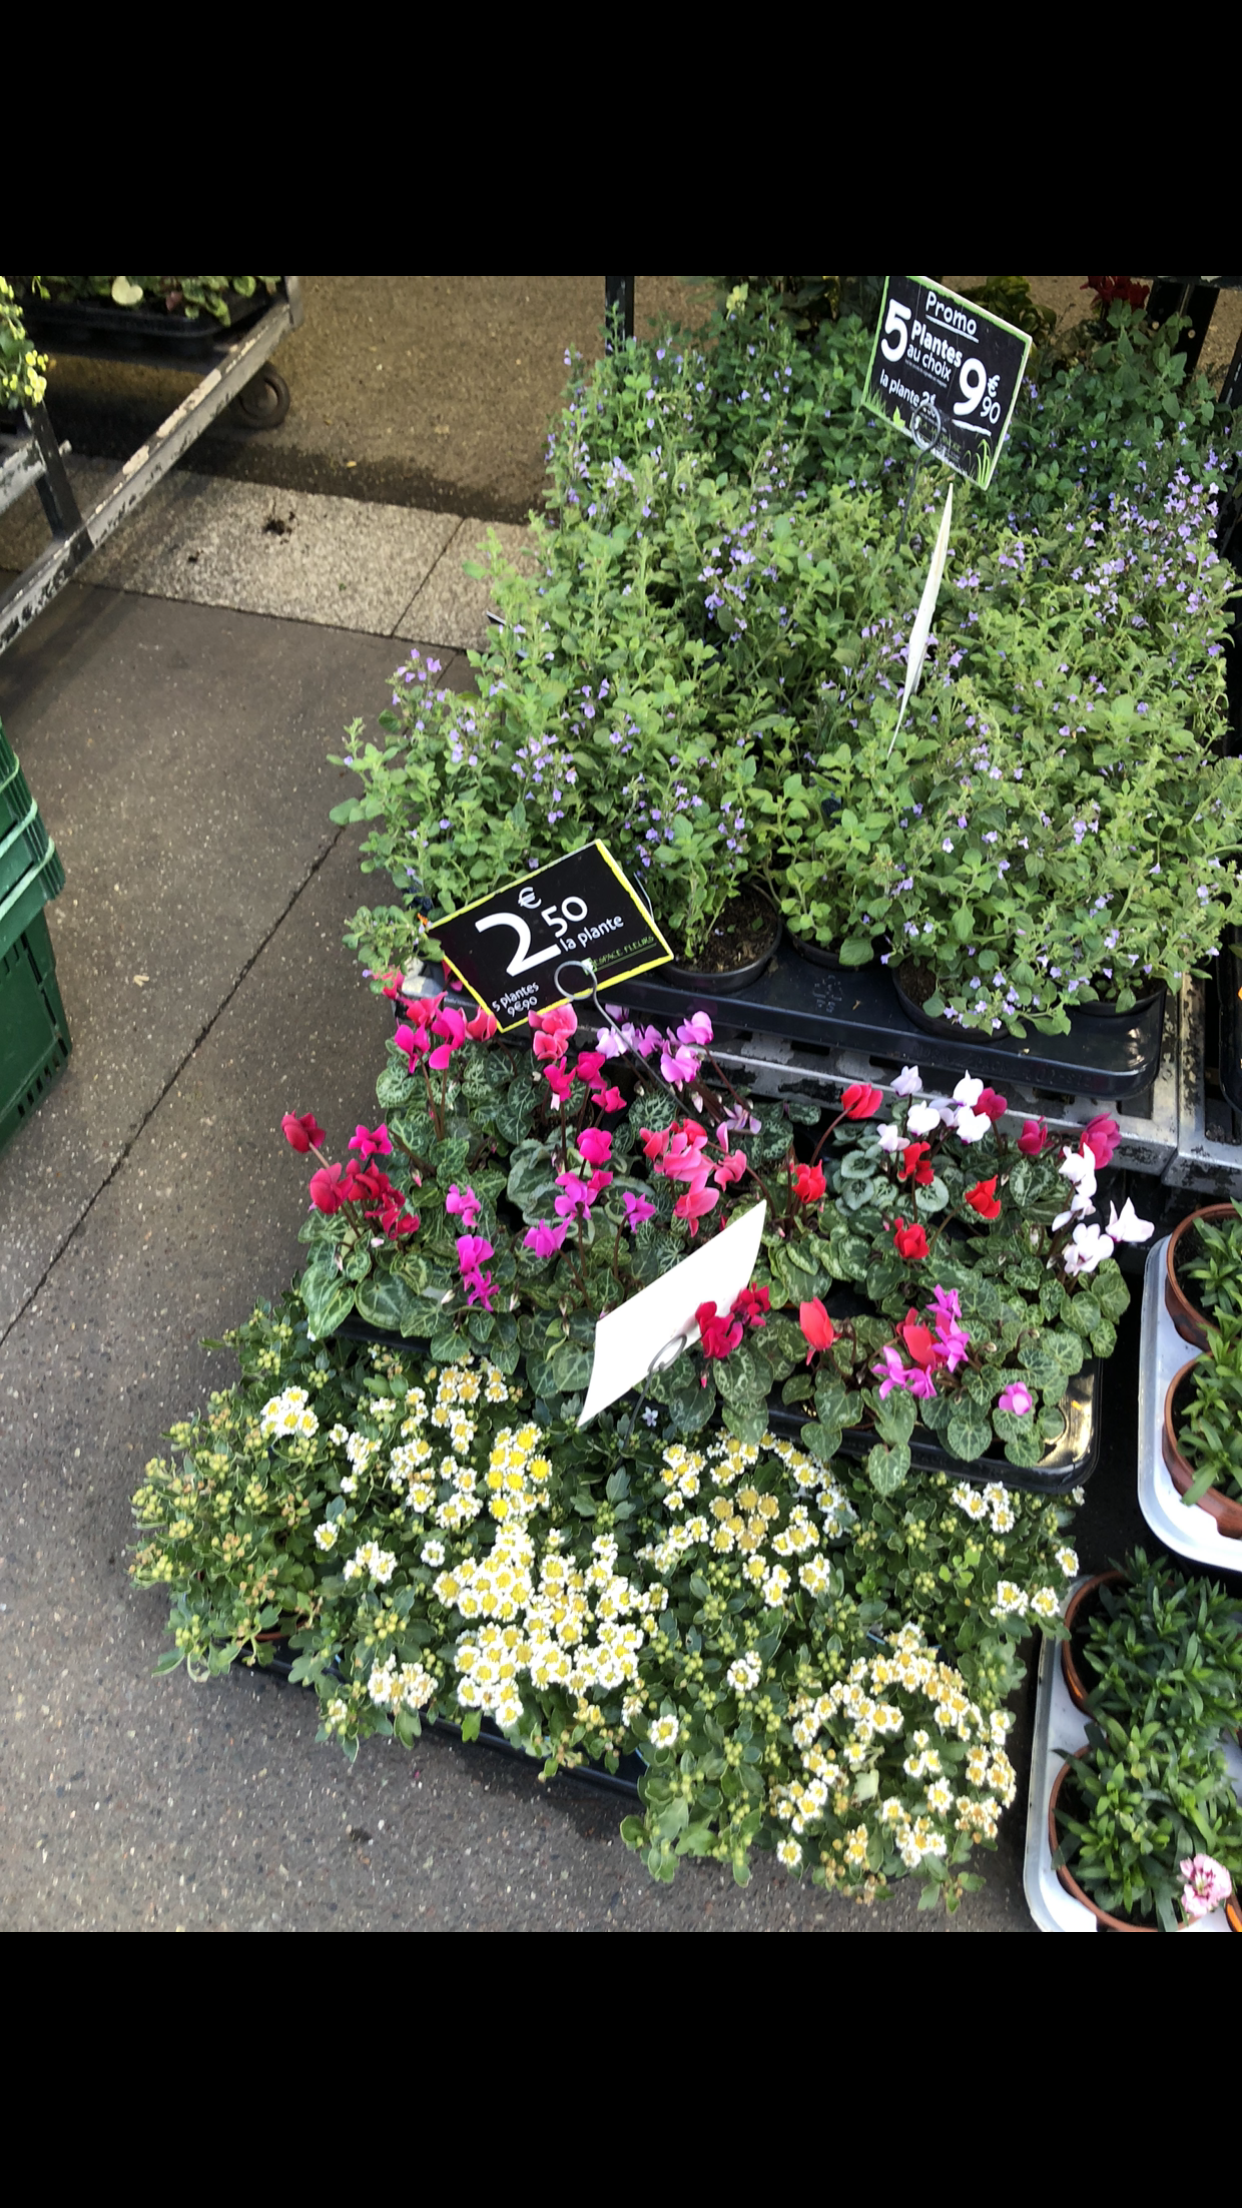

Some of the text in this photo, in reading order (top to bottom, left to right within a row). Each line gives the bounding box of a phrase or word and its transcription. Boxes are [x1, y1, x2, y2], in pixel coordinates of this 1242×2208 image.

[926, 291, 977, 335] Promo
[881, 298, 963, 368] 5 Plantes
[906, 344, 921, 363] au
[922, 351, 952, 382] choix
[879, 368, 889, 387] la
[888, 379, 920, 407] plante
[953, 357, 1001, 424] 9 € 90
[474, 886, 588, 977] 2 € 50
[559, 915, 624, 952] la plante
[492, 982, 539, 1012] 5 plantes
[507, 996, 538, 1018] 9€90
